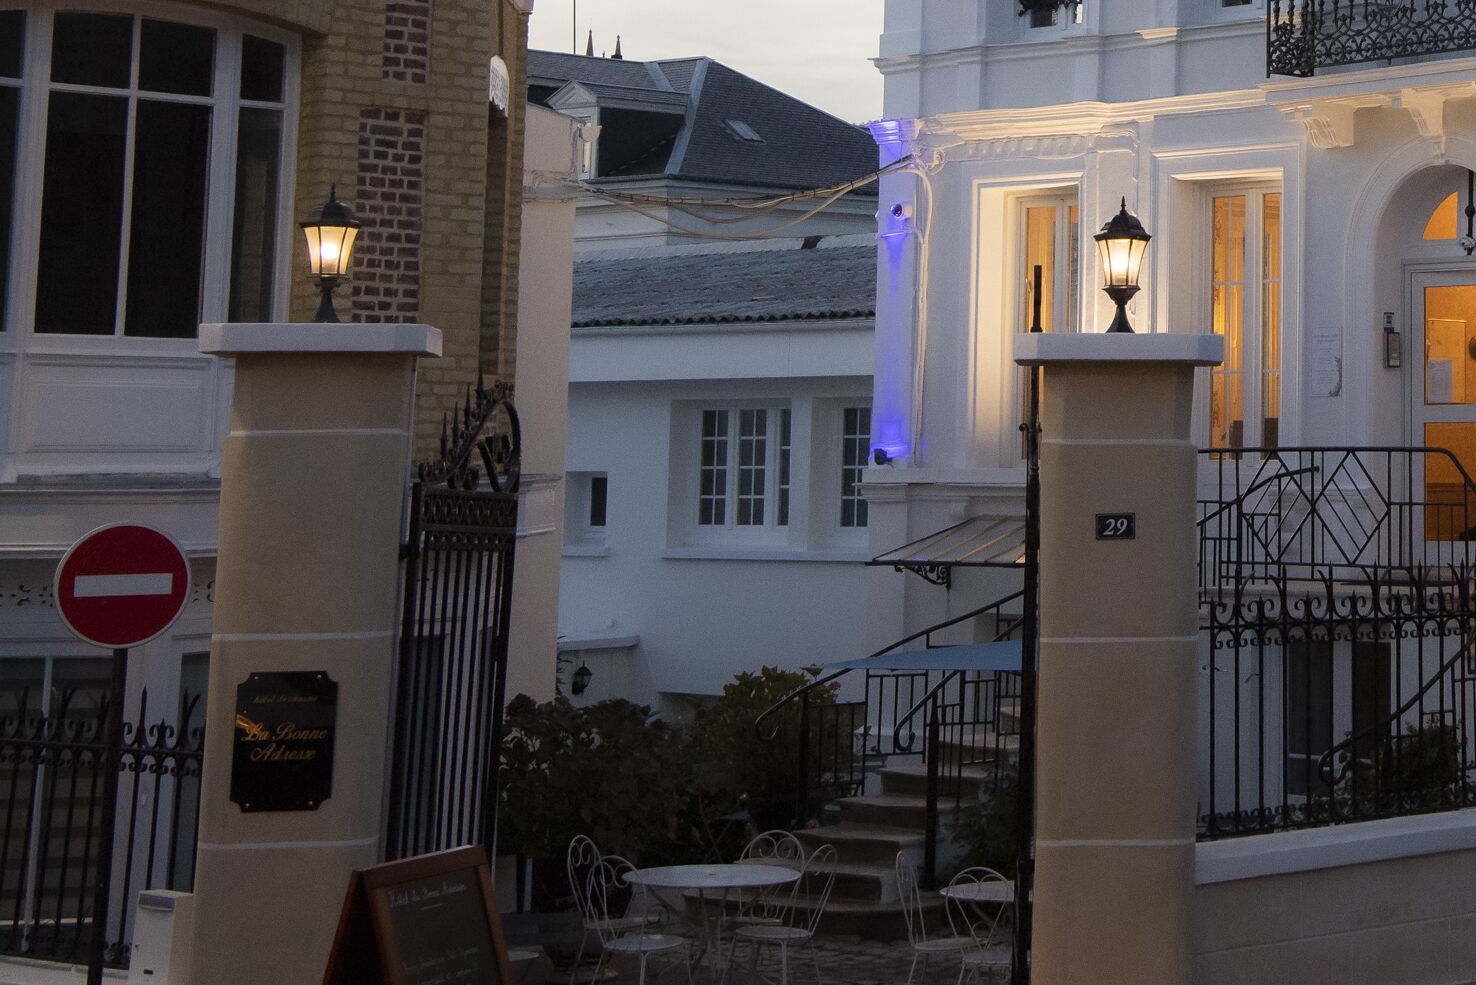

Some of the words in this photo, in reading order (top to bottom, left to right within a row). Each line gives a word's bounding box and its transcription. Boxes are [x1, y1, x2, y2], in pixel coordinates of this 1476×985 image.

[1103, 518, 1128, 535] 29
[241, 722, 270, 741] La
[272, 721, 328, 741] Bonne
[250, 742, 317, 761] Adresse
